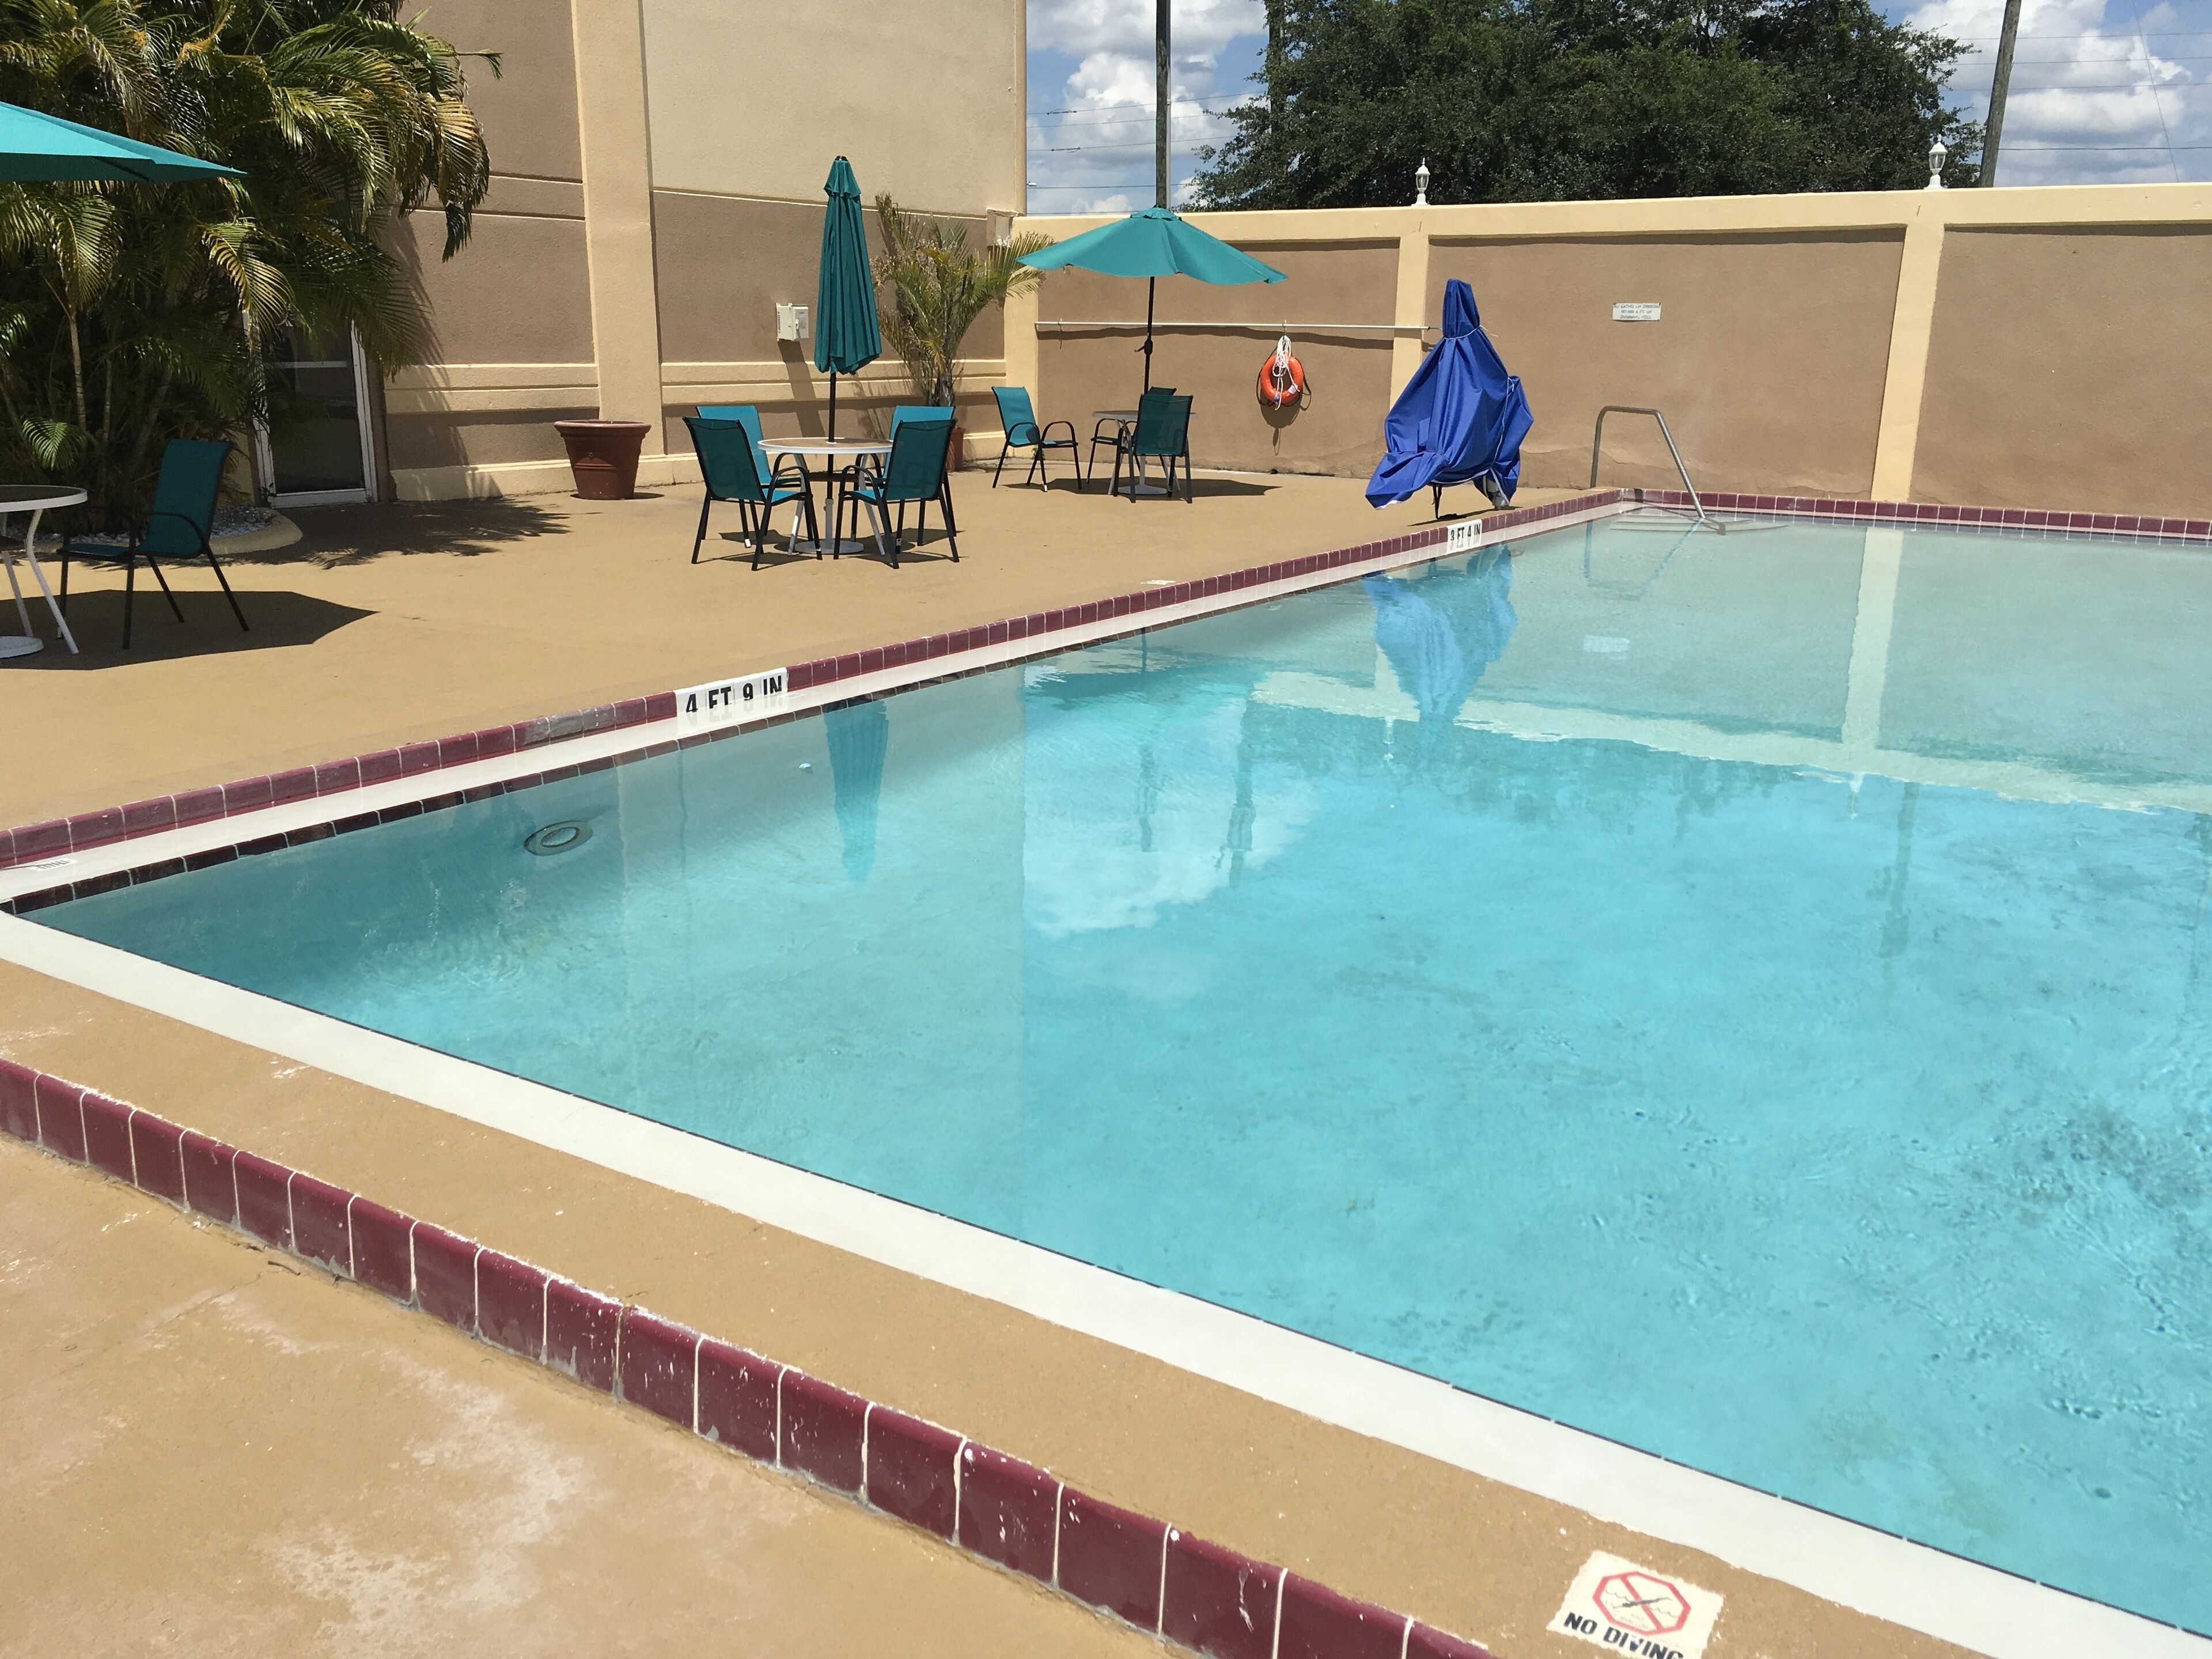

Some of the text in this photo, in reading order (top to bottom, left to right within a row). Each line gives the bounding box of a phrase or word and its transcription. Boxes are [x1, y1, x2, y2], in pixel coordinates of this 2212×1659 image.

[1450, 524, 1480, 541] 3 FT 4 IN
[686, 675, 782, 713] 4 FT 9 IN
[1563, 1612, 1598, 1635] NO
